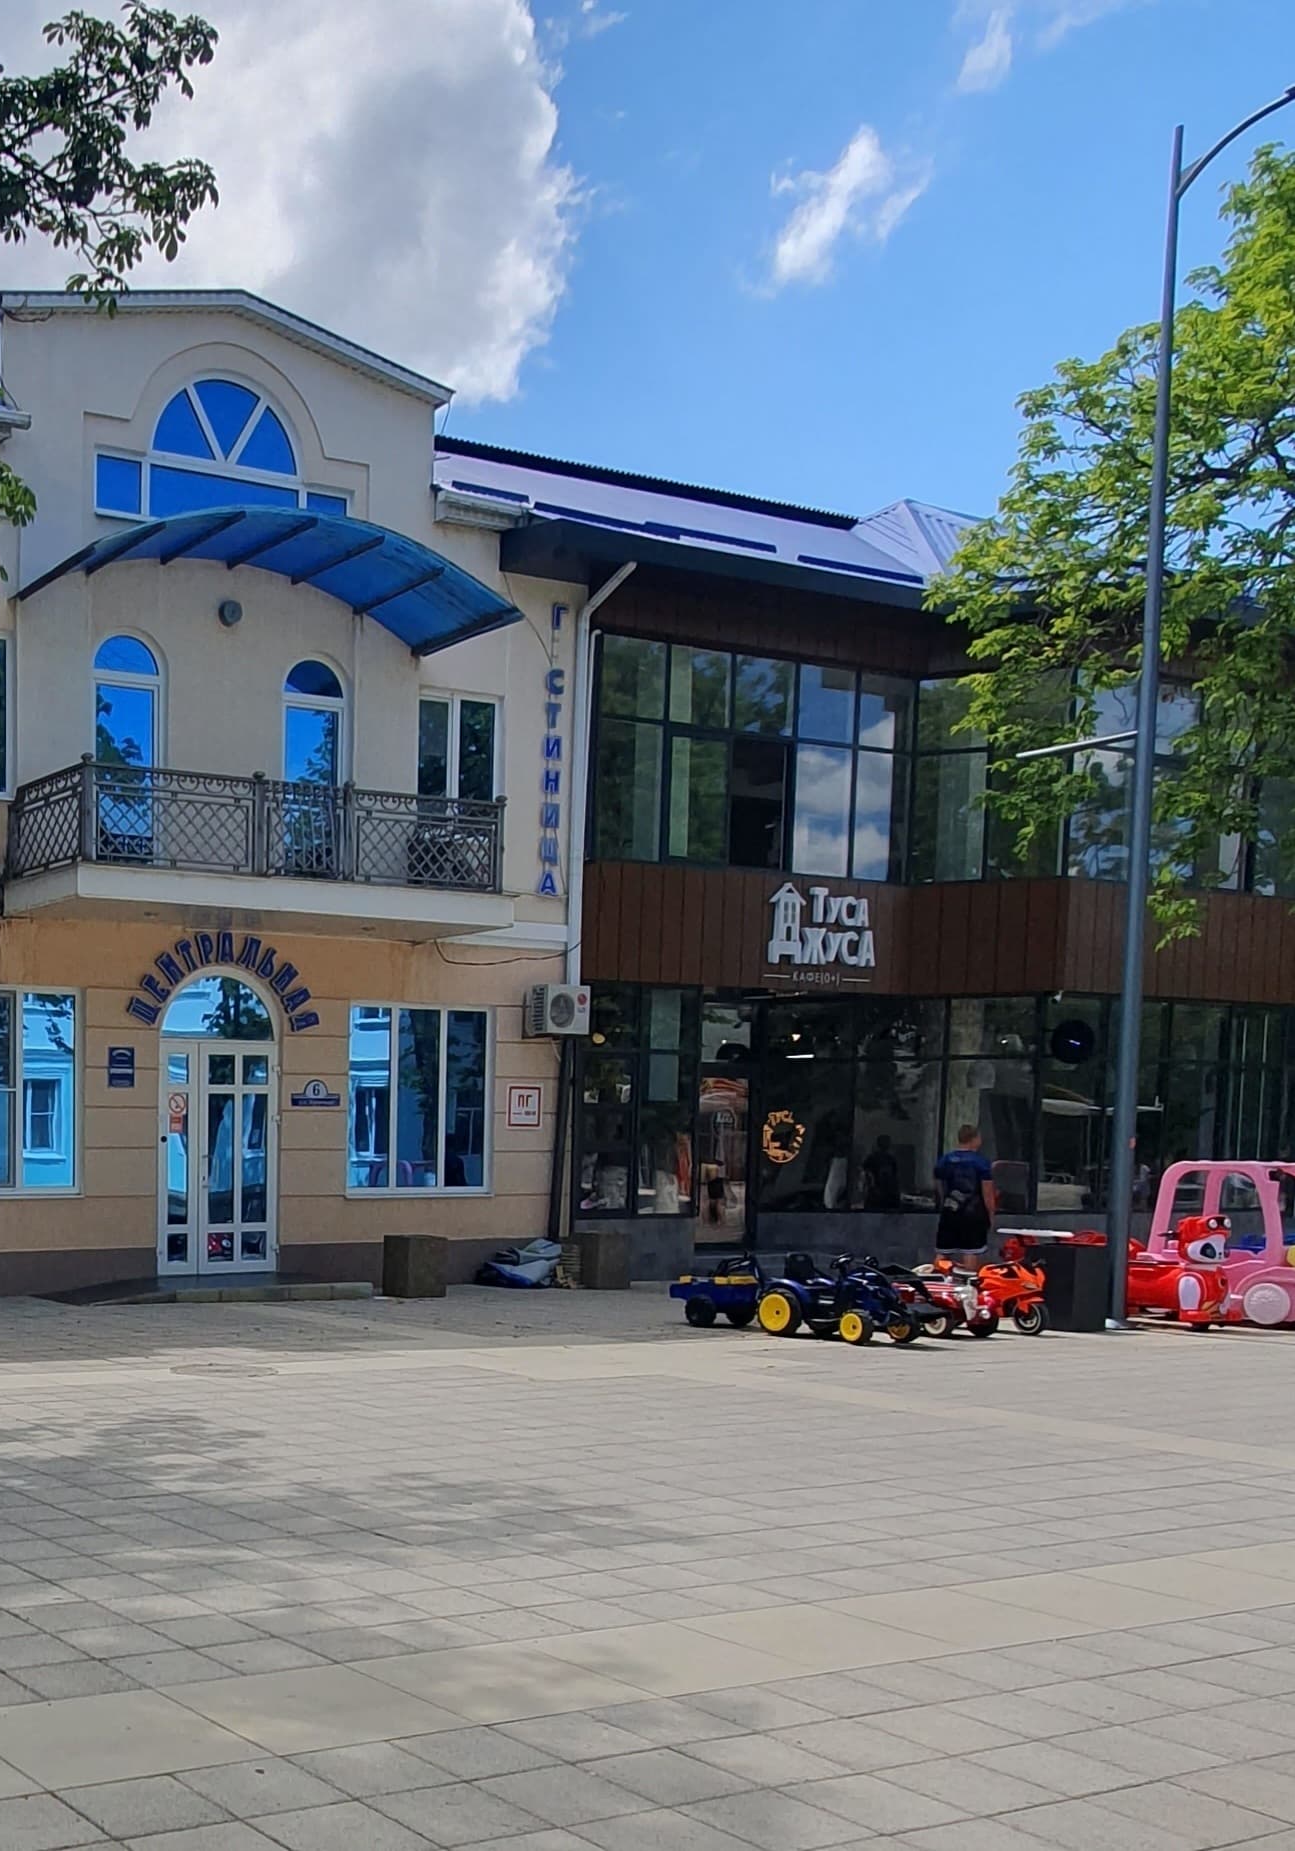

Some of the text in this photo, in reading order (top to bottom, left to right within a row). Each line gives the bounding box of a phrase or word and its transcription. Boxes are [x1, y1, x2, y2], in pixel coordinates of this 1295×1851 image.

[126, 930, 320, 1032] ЦЕНТРАЛЬНАЯ
[312, 1083, 321, 1097] 6
[517, 1094, 533, 1108] ПГ
